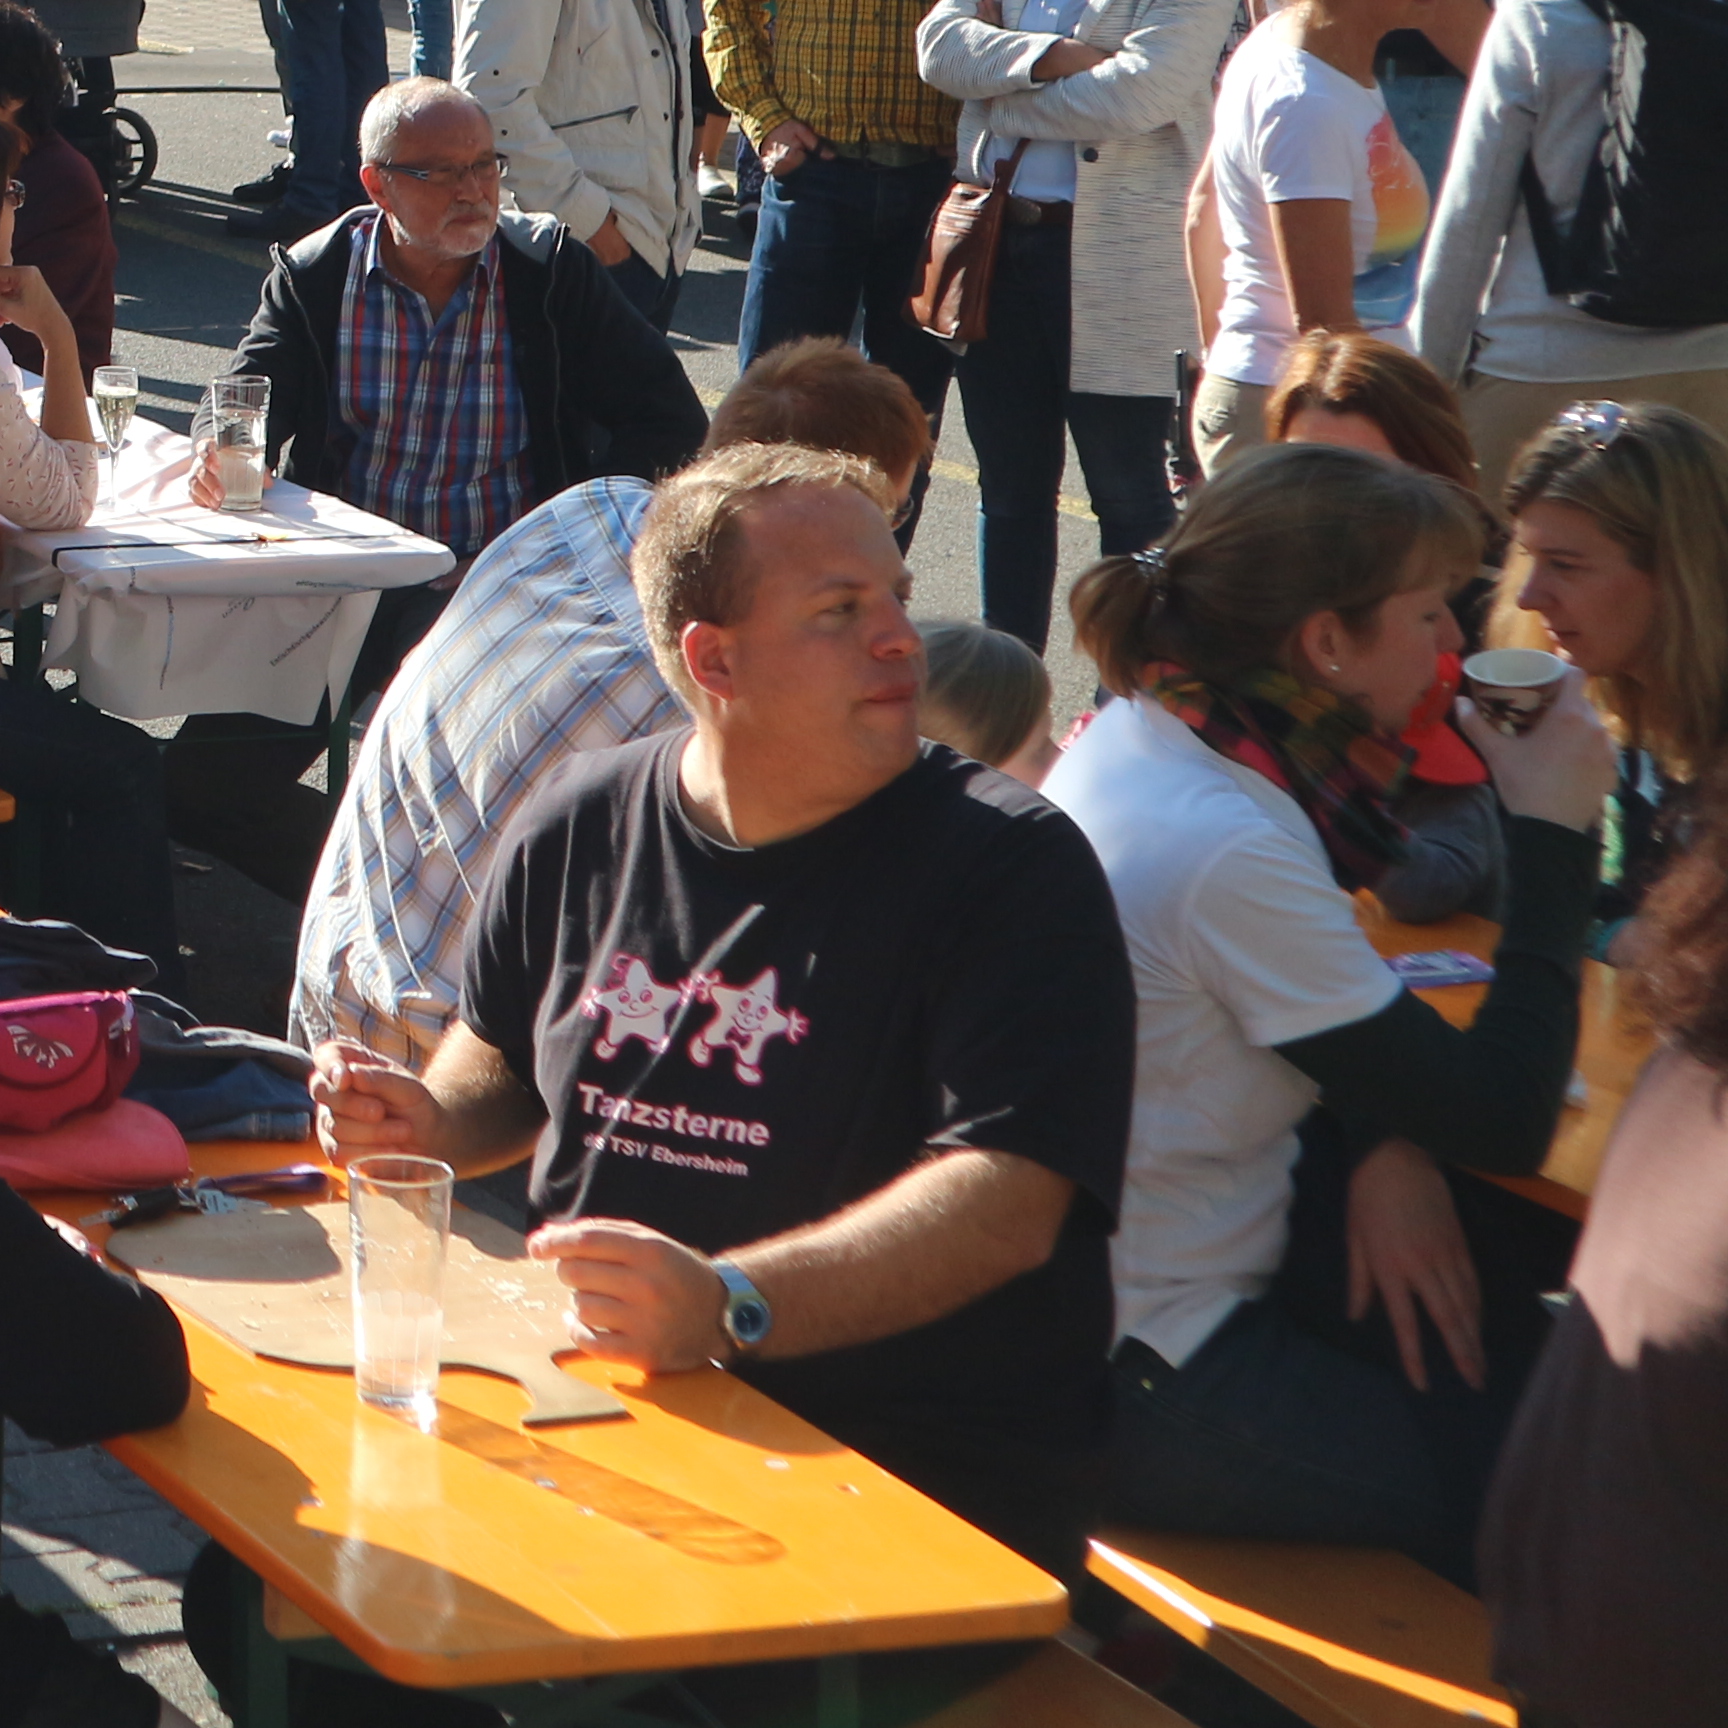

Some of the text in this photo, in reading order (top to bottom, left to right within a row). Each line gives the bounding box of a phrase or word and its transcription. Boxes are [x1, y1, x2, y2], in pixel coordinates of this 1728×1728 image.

[578, 1081, 771, 1147] Tanzsterne
[610, 1135, 649, 1161] TSV
[649, 1143, 749, 1177] Ebersheim
